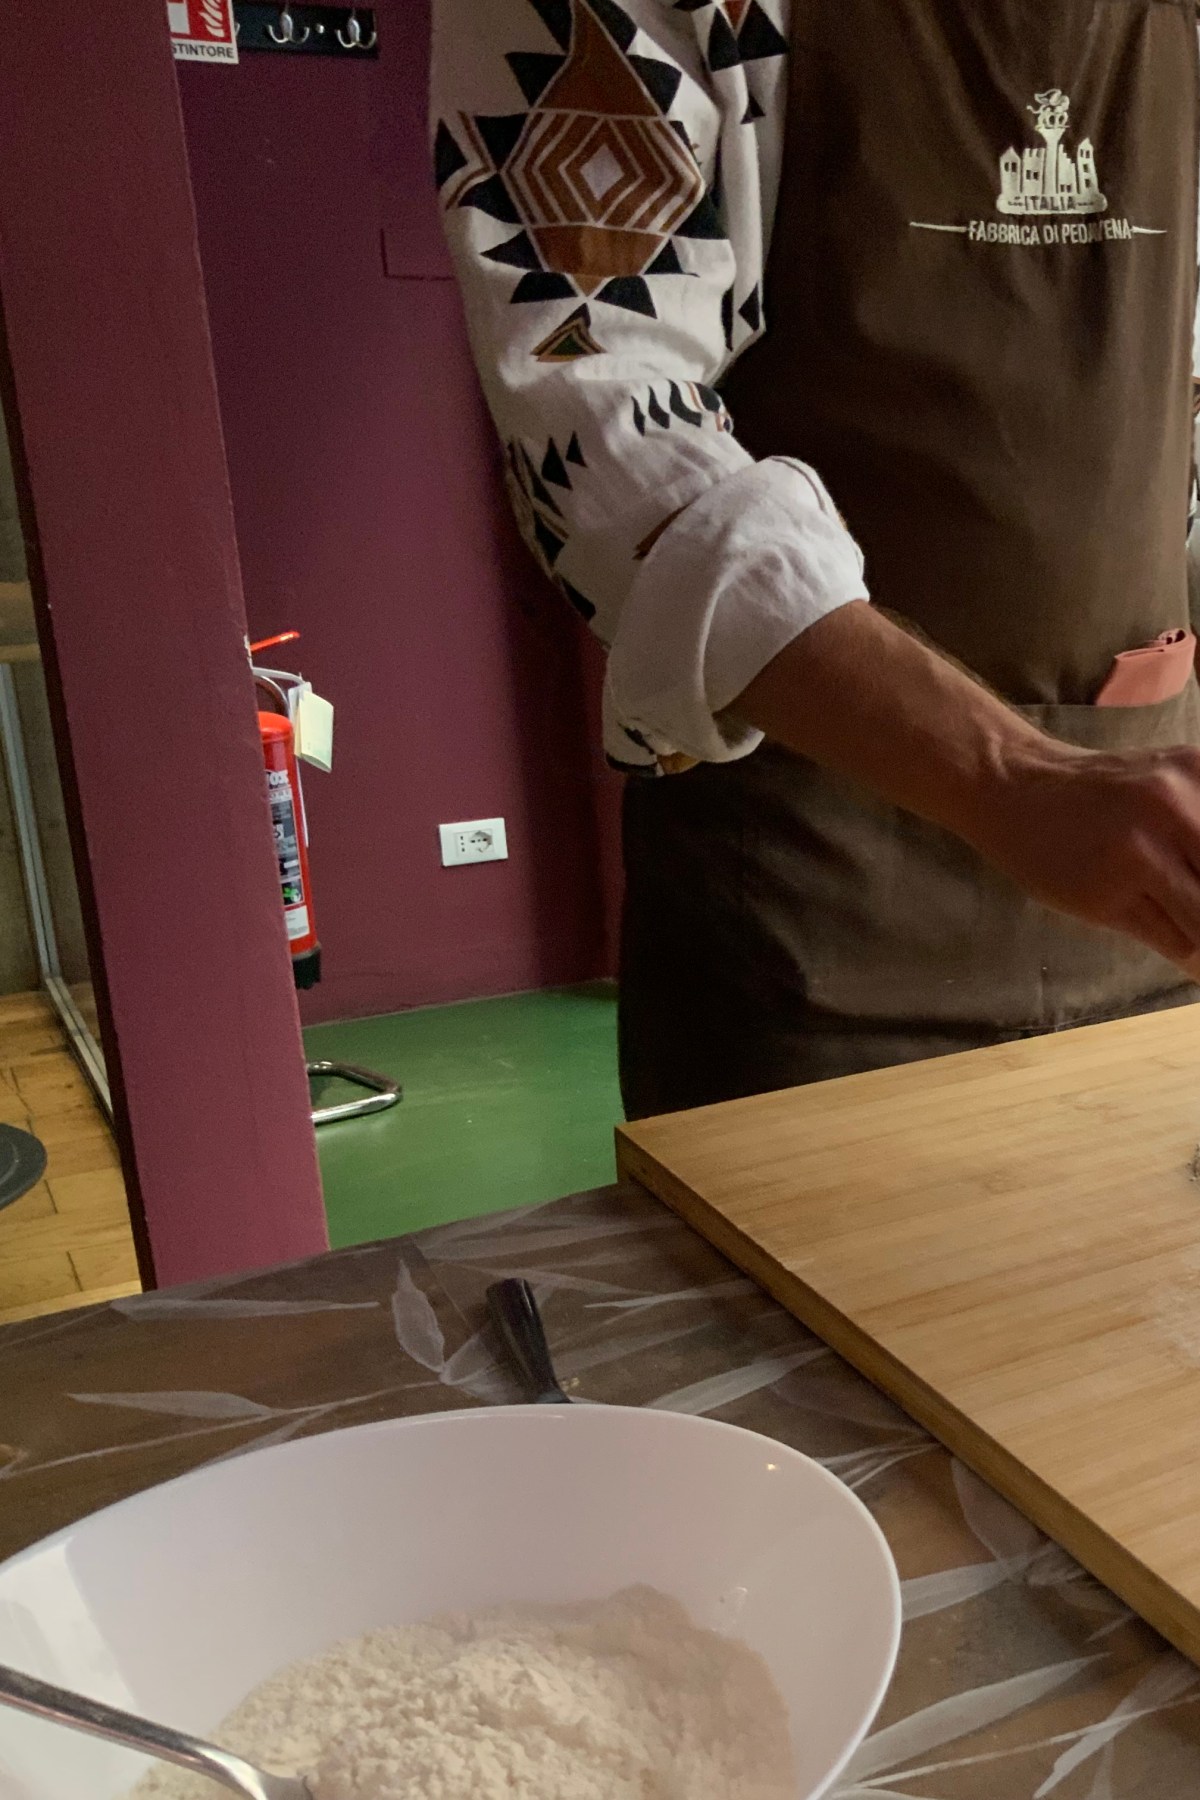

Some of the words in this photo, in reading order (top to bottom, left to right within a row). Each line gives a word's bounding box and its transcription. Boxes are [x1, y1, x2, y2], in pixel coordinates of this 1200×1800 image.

[1023, 195, 1077, 211] ITALIA
[967, 220, 1041, 246] FABBRICA
[1043, 223, 1059, 244] DI
